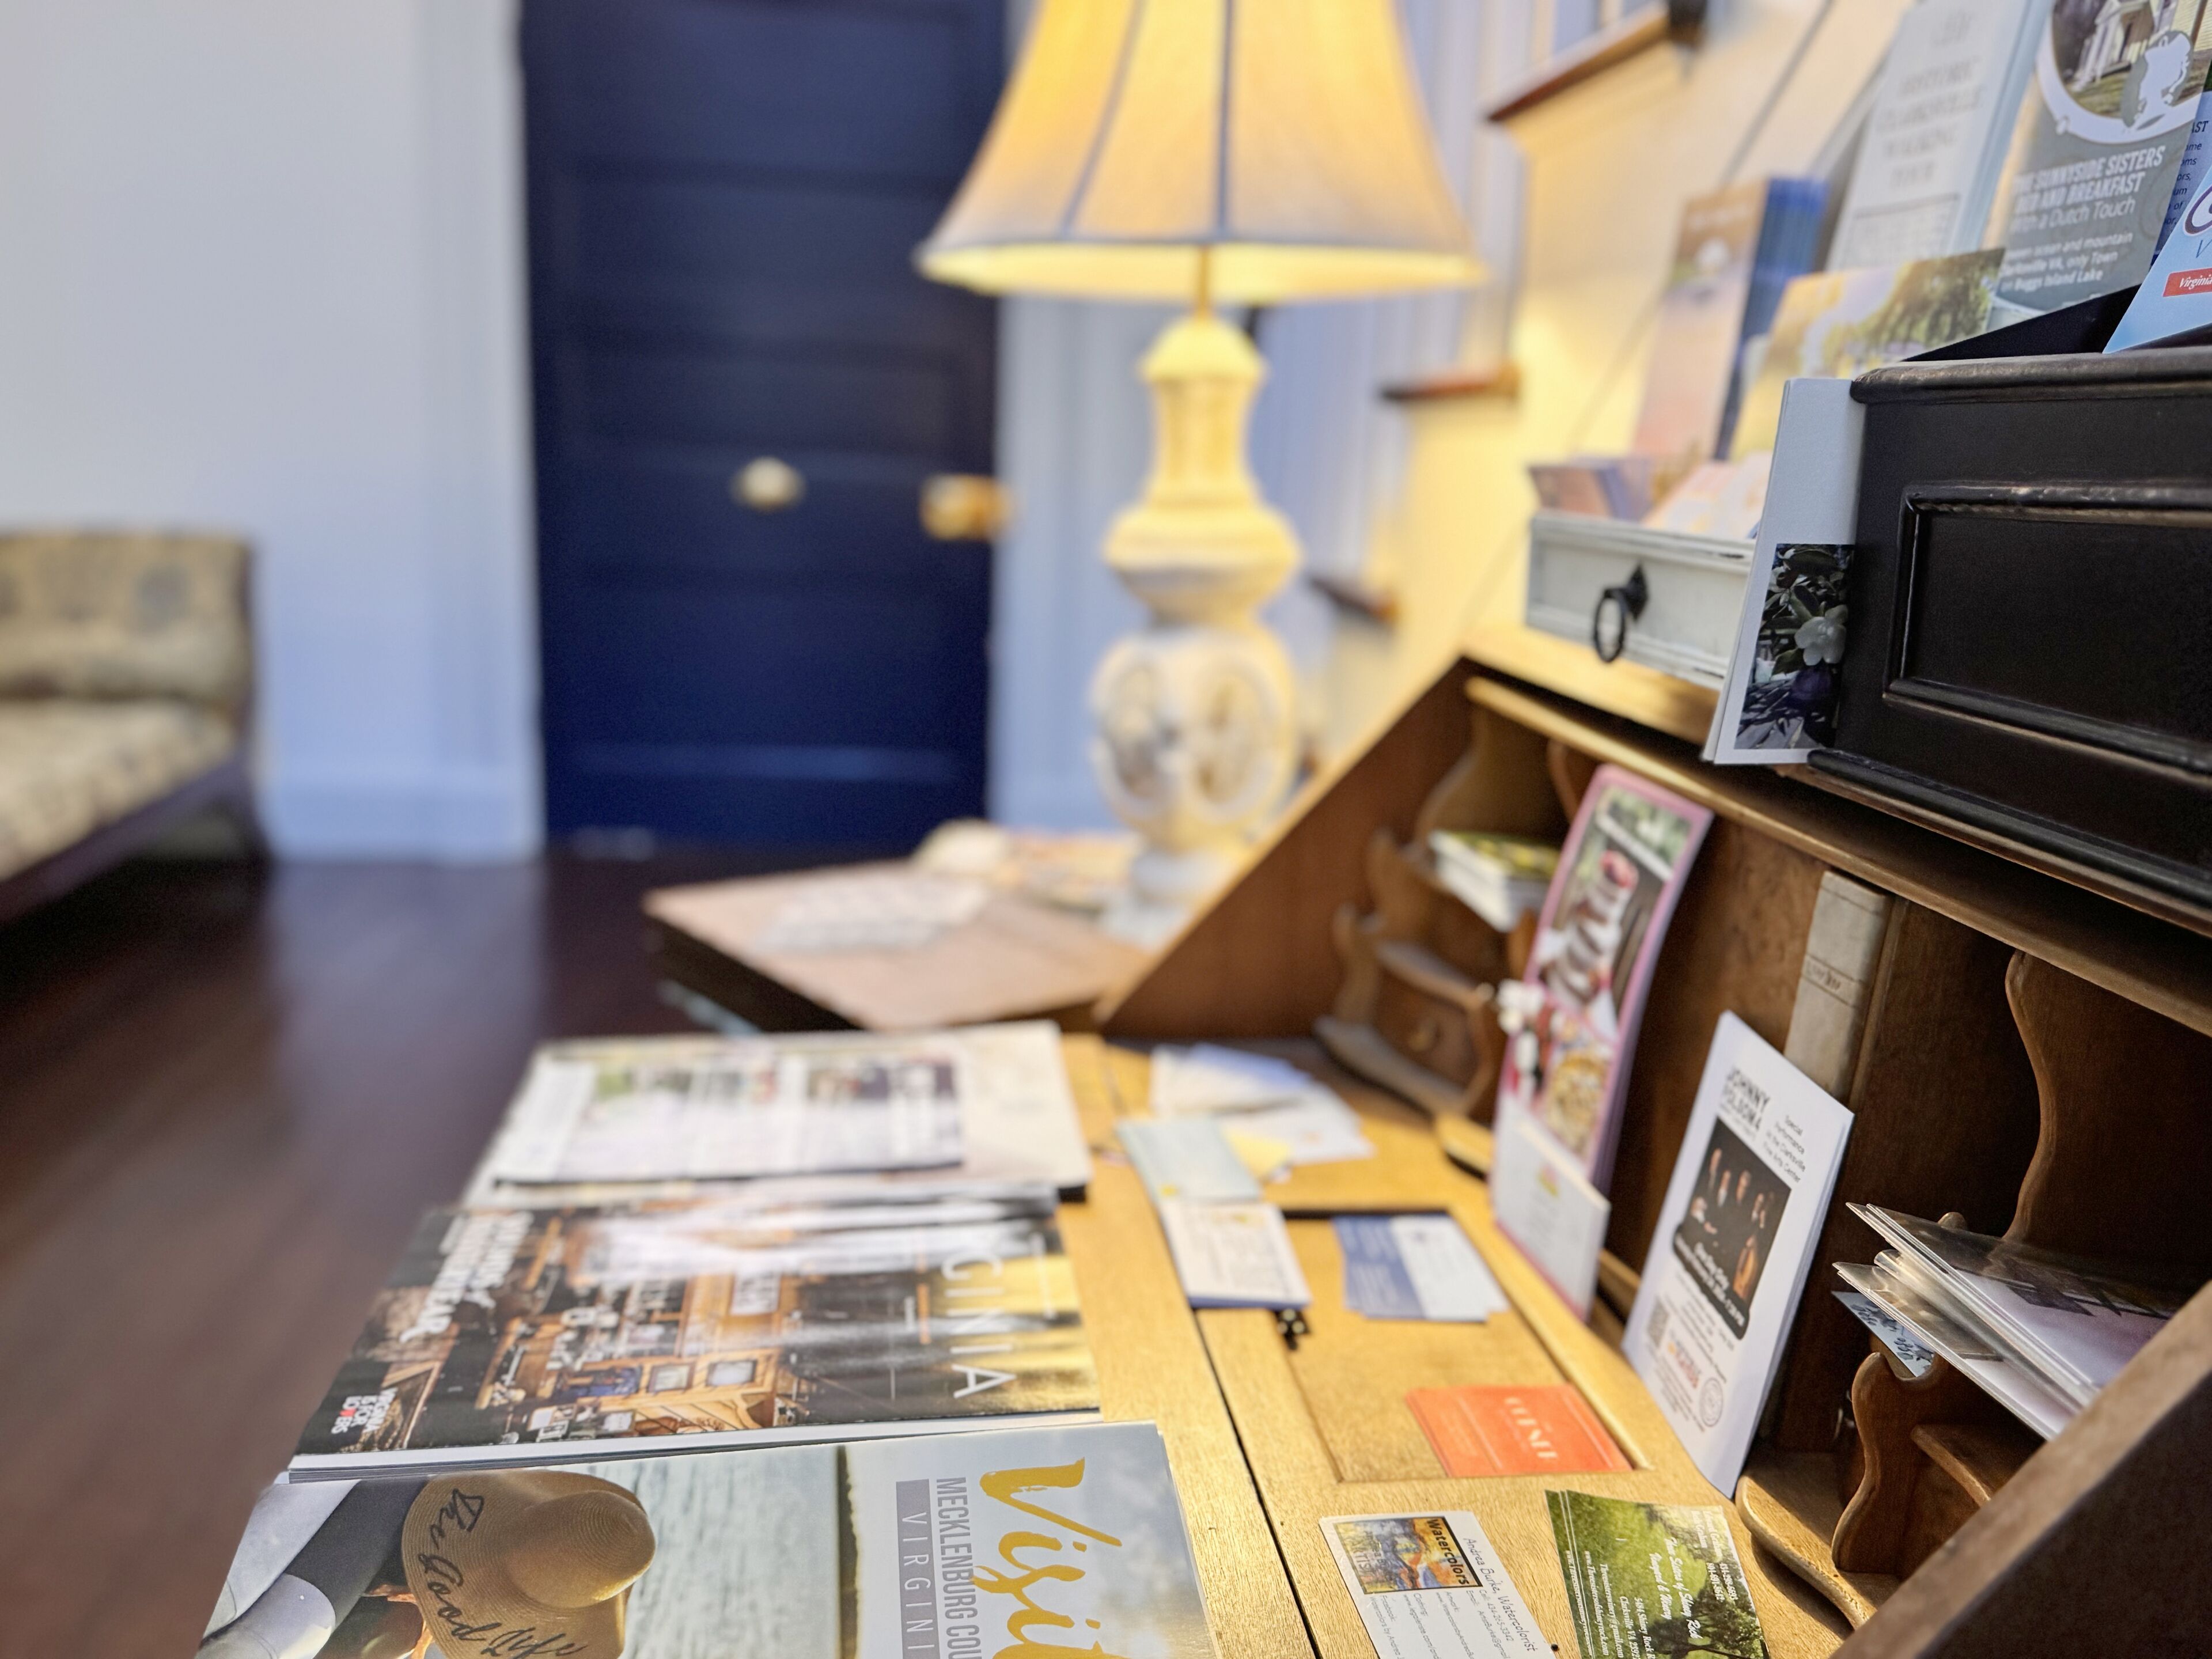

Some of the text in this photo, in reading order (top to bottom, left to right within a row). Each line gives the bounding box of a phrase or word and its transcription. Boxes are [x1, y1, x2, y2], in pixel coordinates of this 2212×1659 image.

[2105, 146, 2165, 176] SISTERS
[2066, 172, 2146, 204] BREAKFAST
[2050, 204, 2089, 228] Dutch
[2093, 197, 2136, 220] Touch
[2083, 232, 2134, 248] mountain
[2077, 268, 2103, 282] Lake
[1785, 1163, 1801, 1183] Center
[350, 1405, 374, 1427] FOR
[936, 1476, 978, 1619] MECKLENBURG
[1426, 1518, 1469, 1586] Watercolors
[419, 1488, 589, 1659] The Good Life
[902, 1512, 935, 1649] VIRGINI
[1669, 1556, 1683, 1582] Sisters
[1463, 1537, 1538, 1652] Andrea Burke, Watercolorist
[1657, 1585, 1671, 1593] &
[1673, 1582, 1689, 1592] of
[1660, 1593, 1673, 1620] Winery
[1679, 1592, 1694, 1618] Shiney
[1619, 1596, 1634, 1630] Clarksville
[1627, 1630, 1637, 1641] VA
[1638, 1613, 1649, 1635] Shiney
[1686, 1619, 1703, 1639] Rock
[1383, 1627, 1391, 1635] by
[1387, 1635, 1401, 1656] Andrea
[1643, 1635, 1654, 1653] Rock
